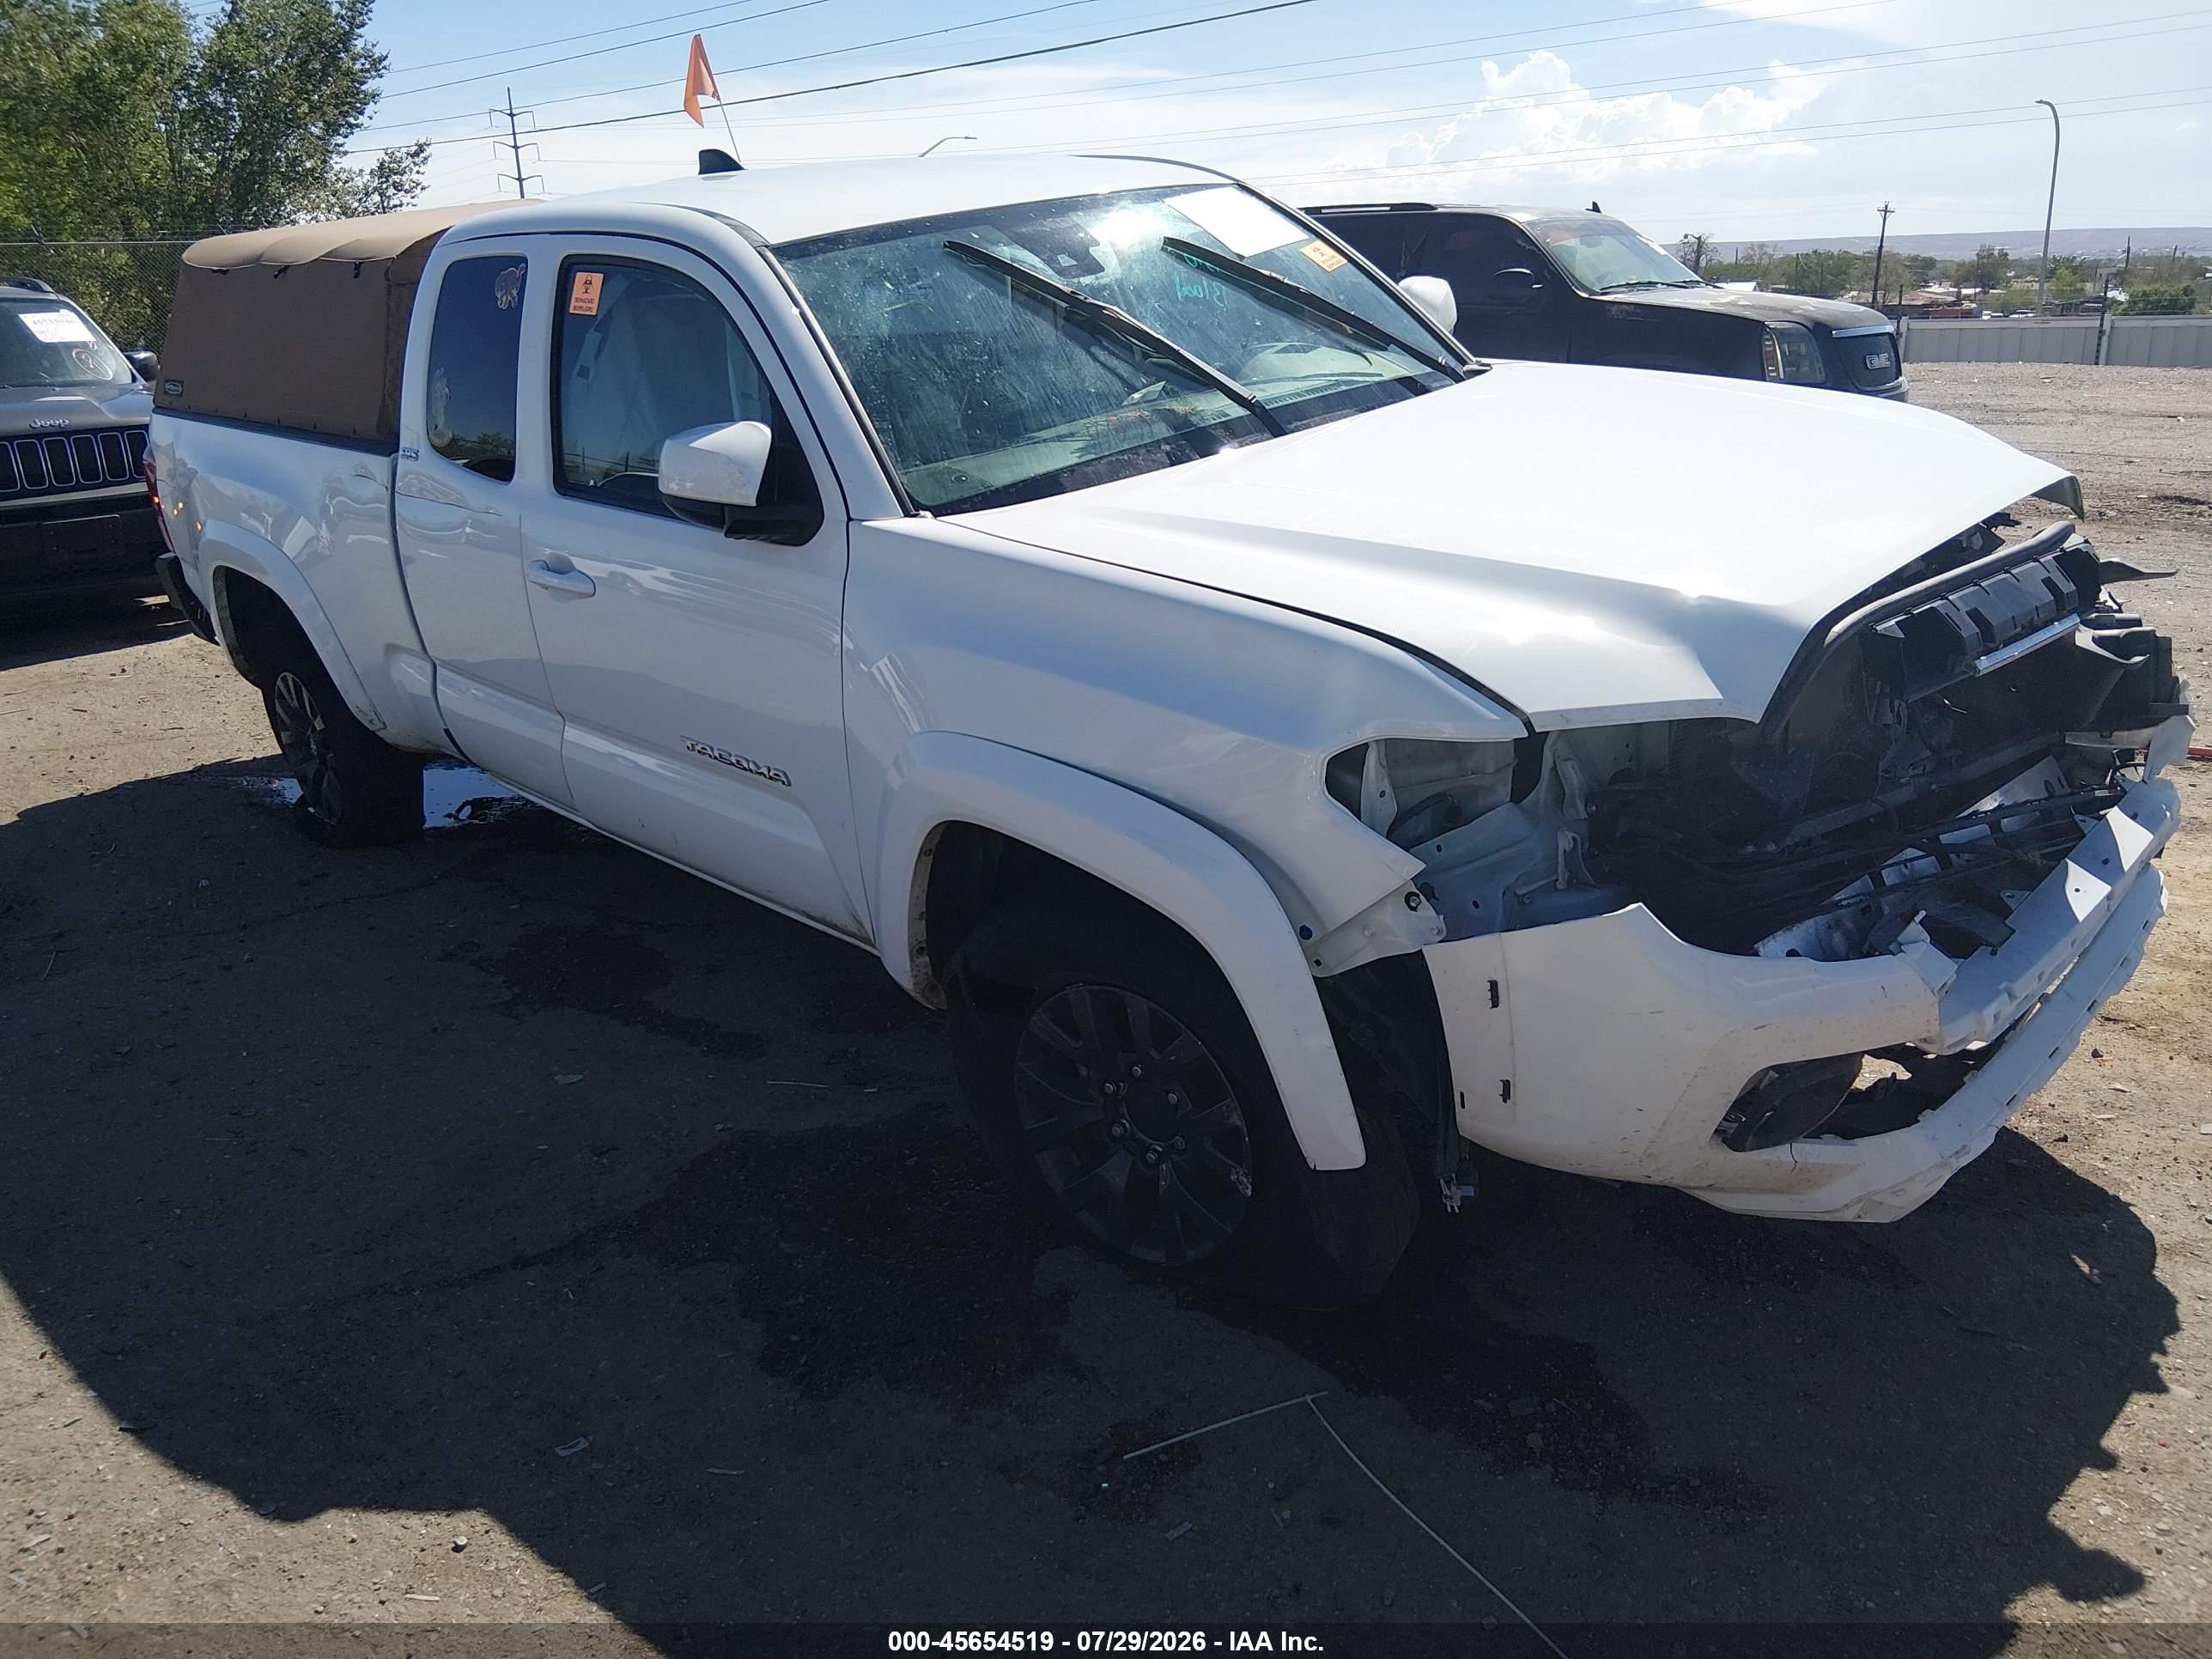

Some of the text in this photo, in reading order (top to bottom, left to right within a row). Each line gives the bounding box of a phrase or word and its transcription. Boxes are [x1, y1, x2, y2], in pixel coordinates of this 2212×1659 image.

[1865, 353, 1891, 369] GMC
[29, 418, 70, 429] Jeep
[680, 734, 792, 787] TACOMA
